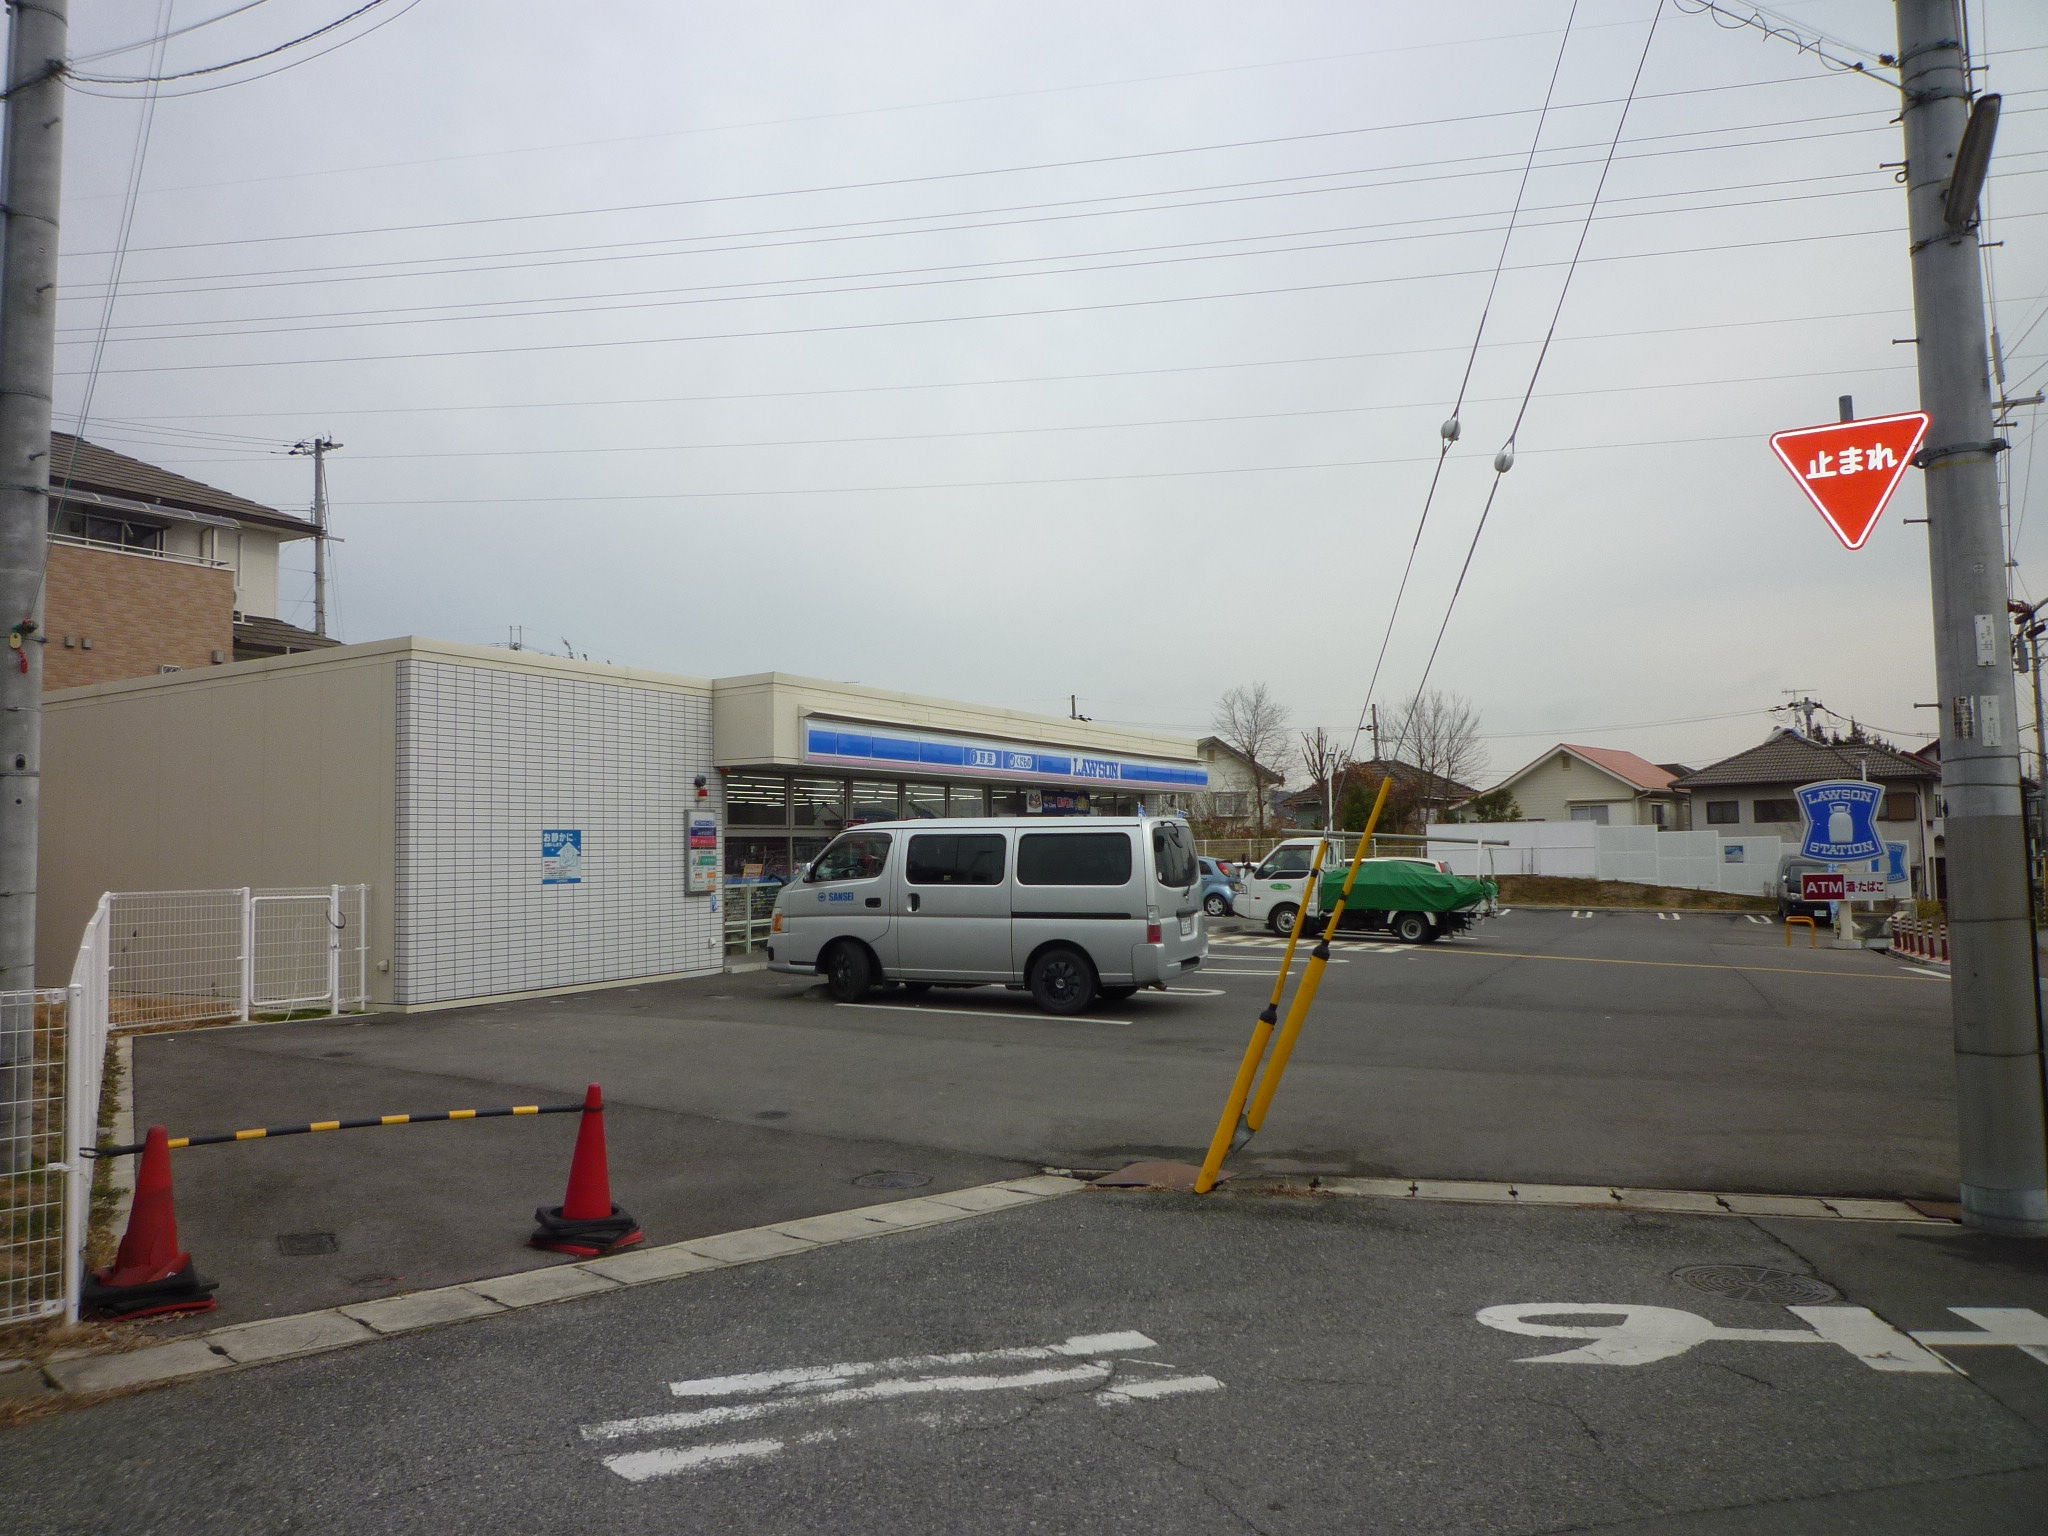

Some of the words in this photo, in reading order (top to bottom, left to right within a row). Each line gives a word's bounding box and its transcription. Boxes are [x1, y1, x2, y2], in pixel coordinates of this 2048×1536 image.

[1805, 442, 1898, 480] 止まれ
[979, 752, 993, 765] 野菜
[1015, 756, 1031, 768] くだもの
[1073, 757, 1119, 779] LAWSON
[1806, 790, 1873, 804] LAWSON
[1809, 840, 1875, 855] STATION
[1806, 881, 1843, 893] ATM
[829, 891, 854, 901] SANSEI
